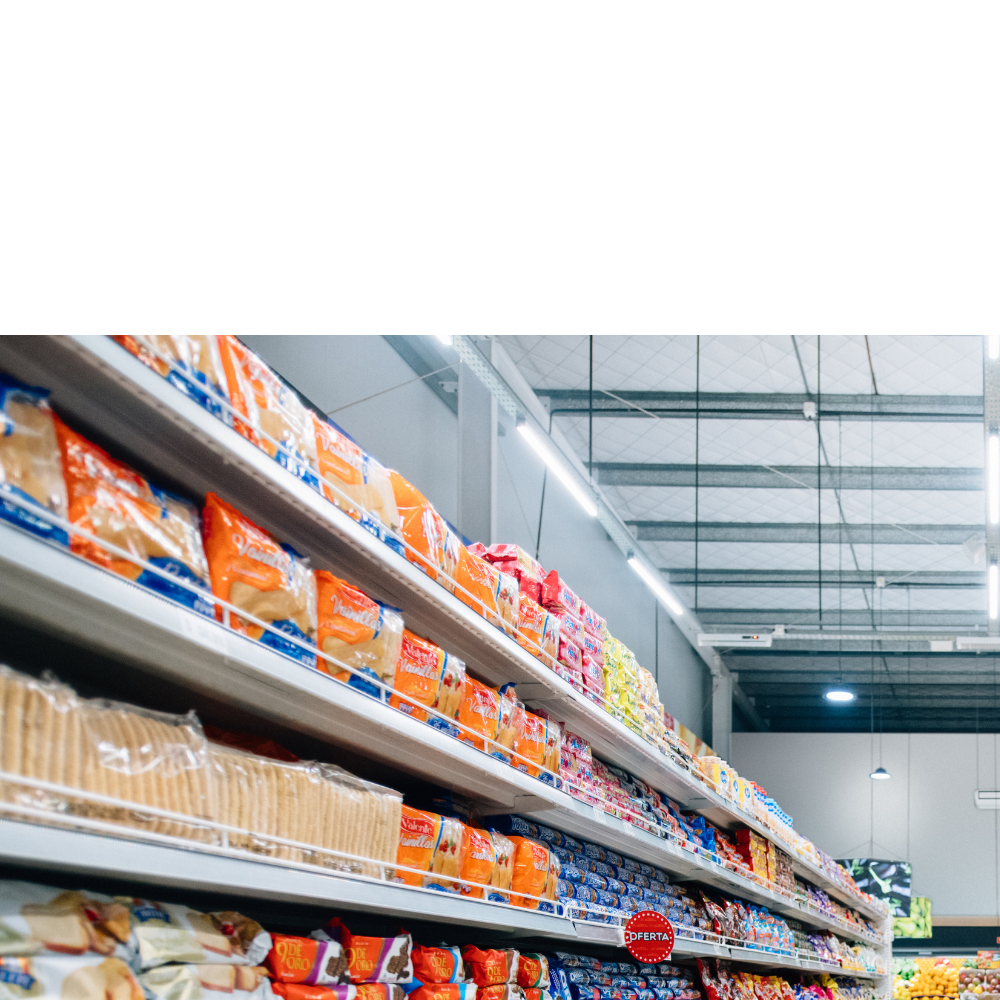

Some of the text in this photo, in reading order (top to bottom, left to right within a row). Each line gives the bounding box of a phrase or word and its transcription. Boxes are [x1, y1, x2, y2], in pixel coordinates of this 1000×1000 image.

[401, 818, 434, 835] Valente
[629, 932, 669, 941] OFERTA
[277, 942, 301, 966] 9 DE
[356, 948, 366, 959] DE
[287, 958, 310, 971] ORO
[356, 959, 373, 971] ORO
